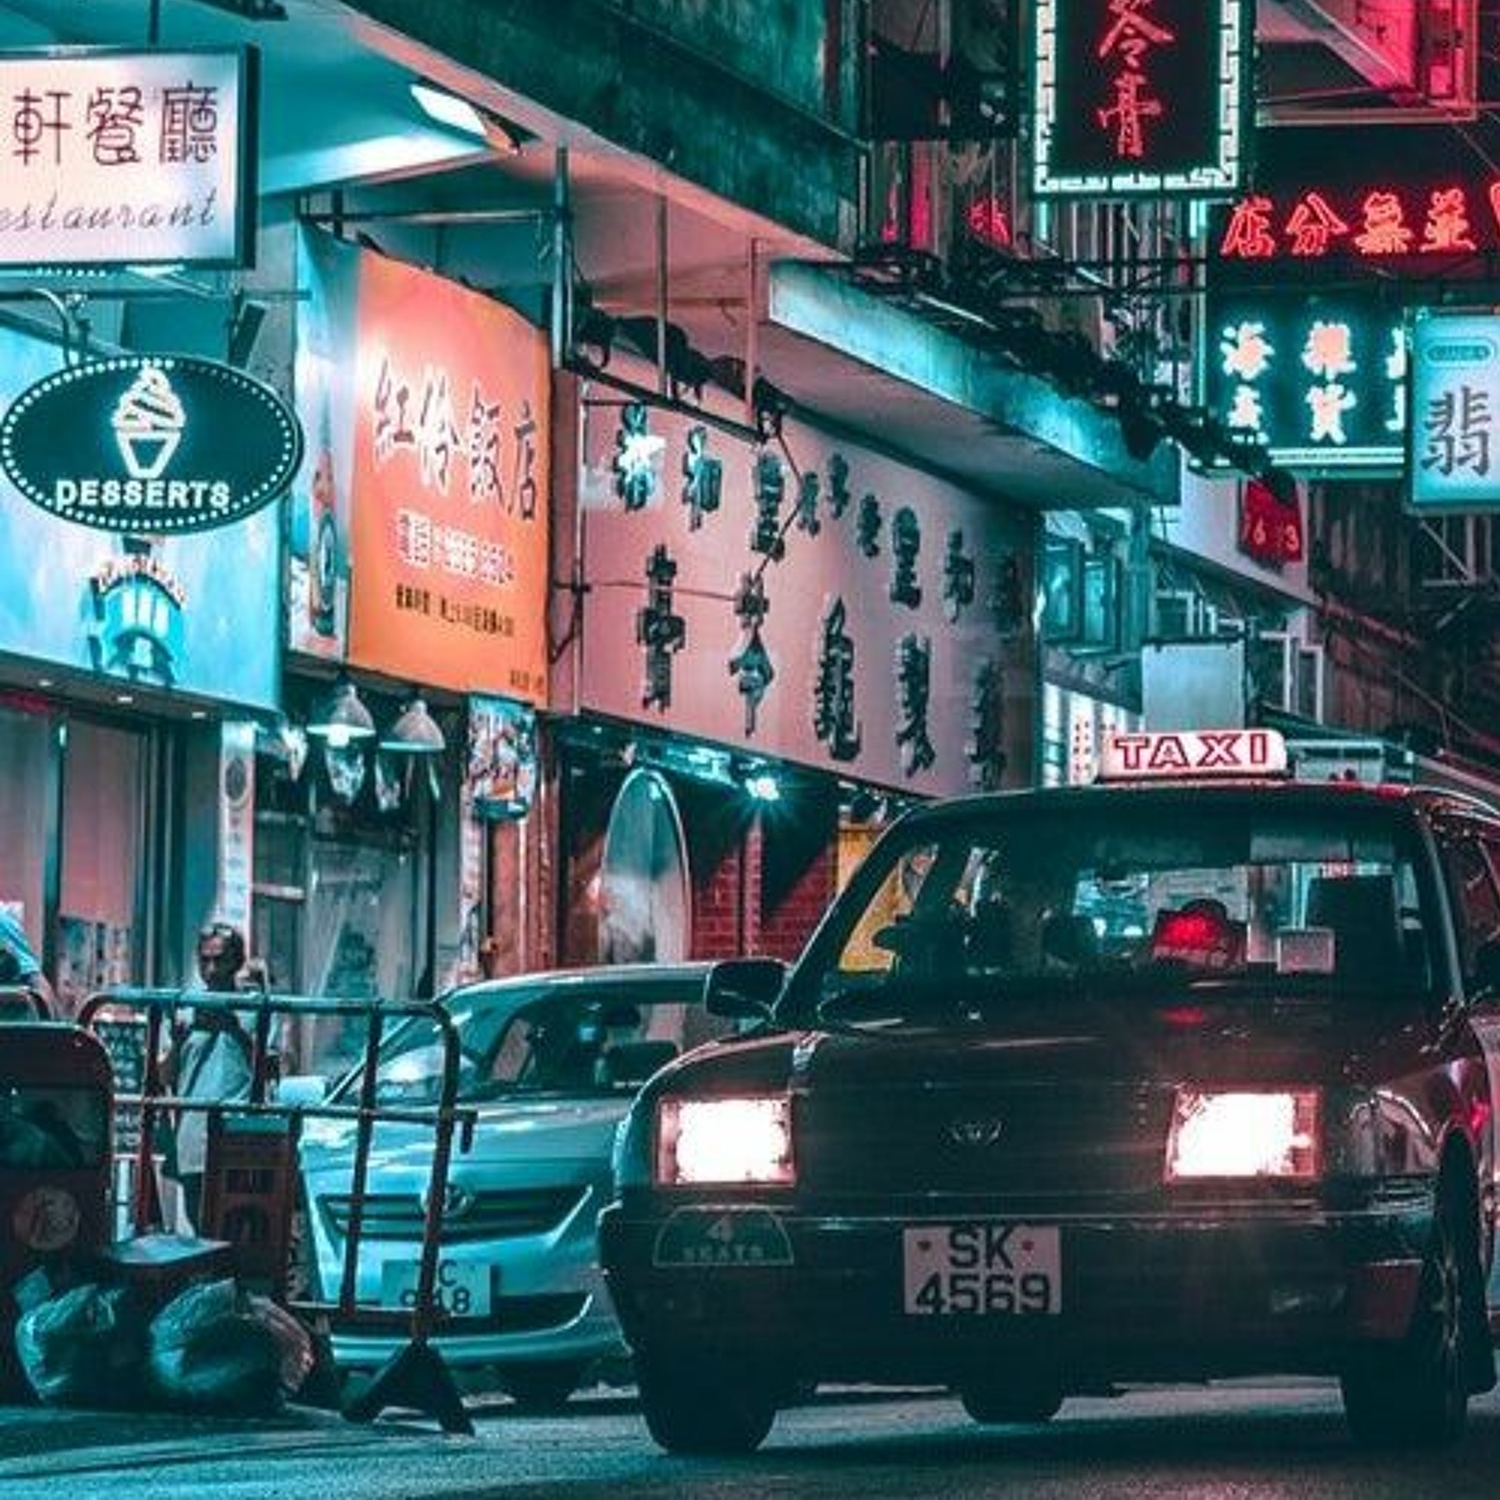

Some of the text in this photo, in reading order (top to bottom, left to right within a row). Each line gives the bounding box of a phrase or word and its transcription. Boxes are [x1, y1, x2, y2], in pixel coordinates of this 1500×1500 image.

[56, 479, 231, 509] DESSERTS
[1114, 733, 1268, 770] TAXI
[706, 1216, 734, 1244] 4
[948, 1224, 1016, 1269] SK
[915, 1271, 1052, 1314] 4569
